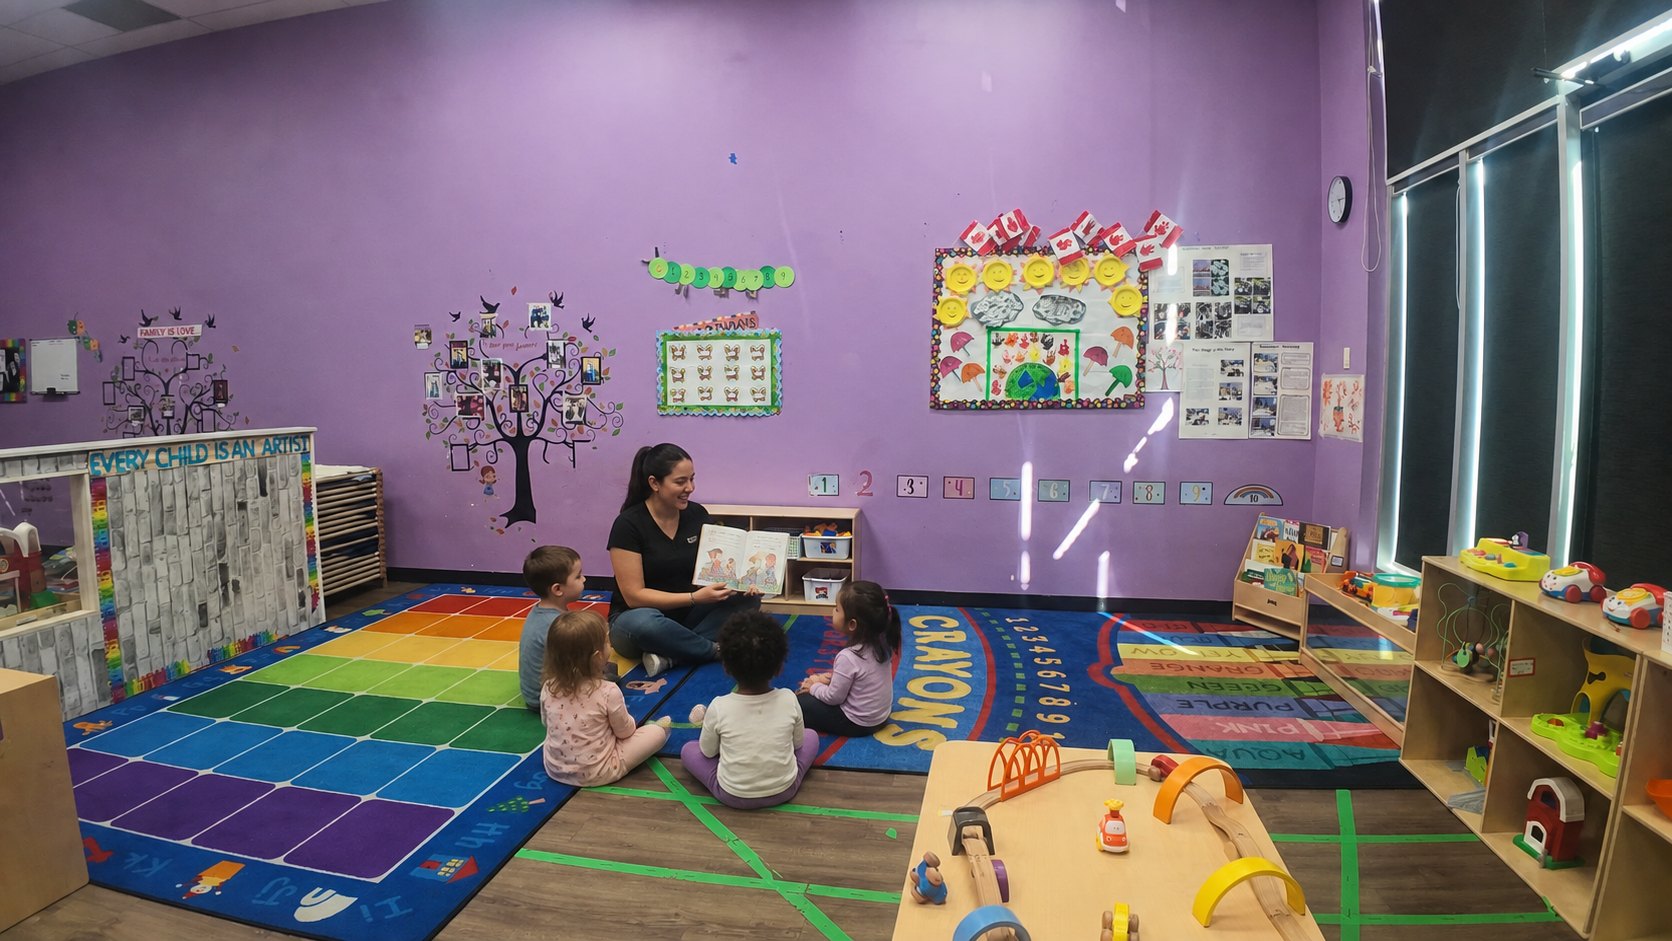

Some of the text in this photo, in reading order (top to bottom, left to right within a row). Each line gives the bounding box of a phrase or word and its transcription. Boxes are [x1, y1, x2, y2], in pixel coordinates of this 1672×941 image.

[684, 270, 690, 279] 2
[765, 272, 771, 281] 8
[780, 271, 786, 280] 9
[140, 326, 195, 336] FAMILY IS LOVE
[89, 448, 150, 476] EVERY
[155, 442, 209, 468] CHILD
[214, 440, 229, 461] IS
[231, 439, 255, 460] AN
[821, 470, 1259, 503] 1 2 3 4 5 6 7 8 9 10
[1022, 635, 1049, 643] 3
[1029, 645, 1056, 654] 4
[1033, 657, 1062, 666] 5
[1036, 669, 1067, 679] 6
[872, 615, 973, 751] CRAYONS
[1039, 682, 1071, 693] 7
[1038, 696, 1072, 707] 8
[1177, 699, 1295, 712] PURPLE
[1036, 712, 1071, 724] 9
[1216, 721, 1300, 735] PINK
[1206, 747, 1306, 761] AQUA
[455, 822, 510, 850] Hh
[123, 851, 174, 878] Kk
[251, 876, 299, 907] Jj
[359, 895, 414, 923] Ii
